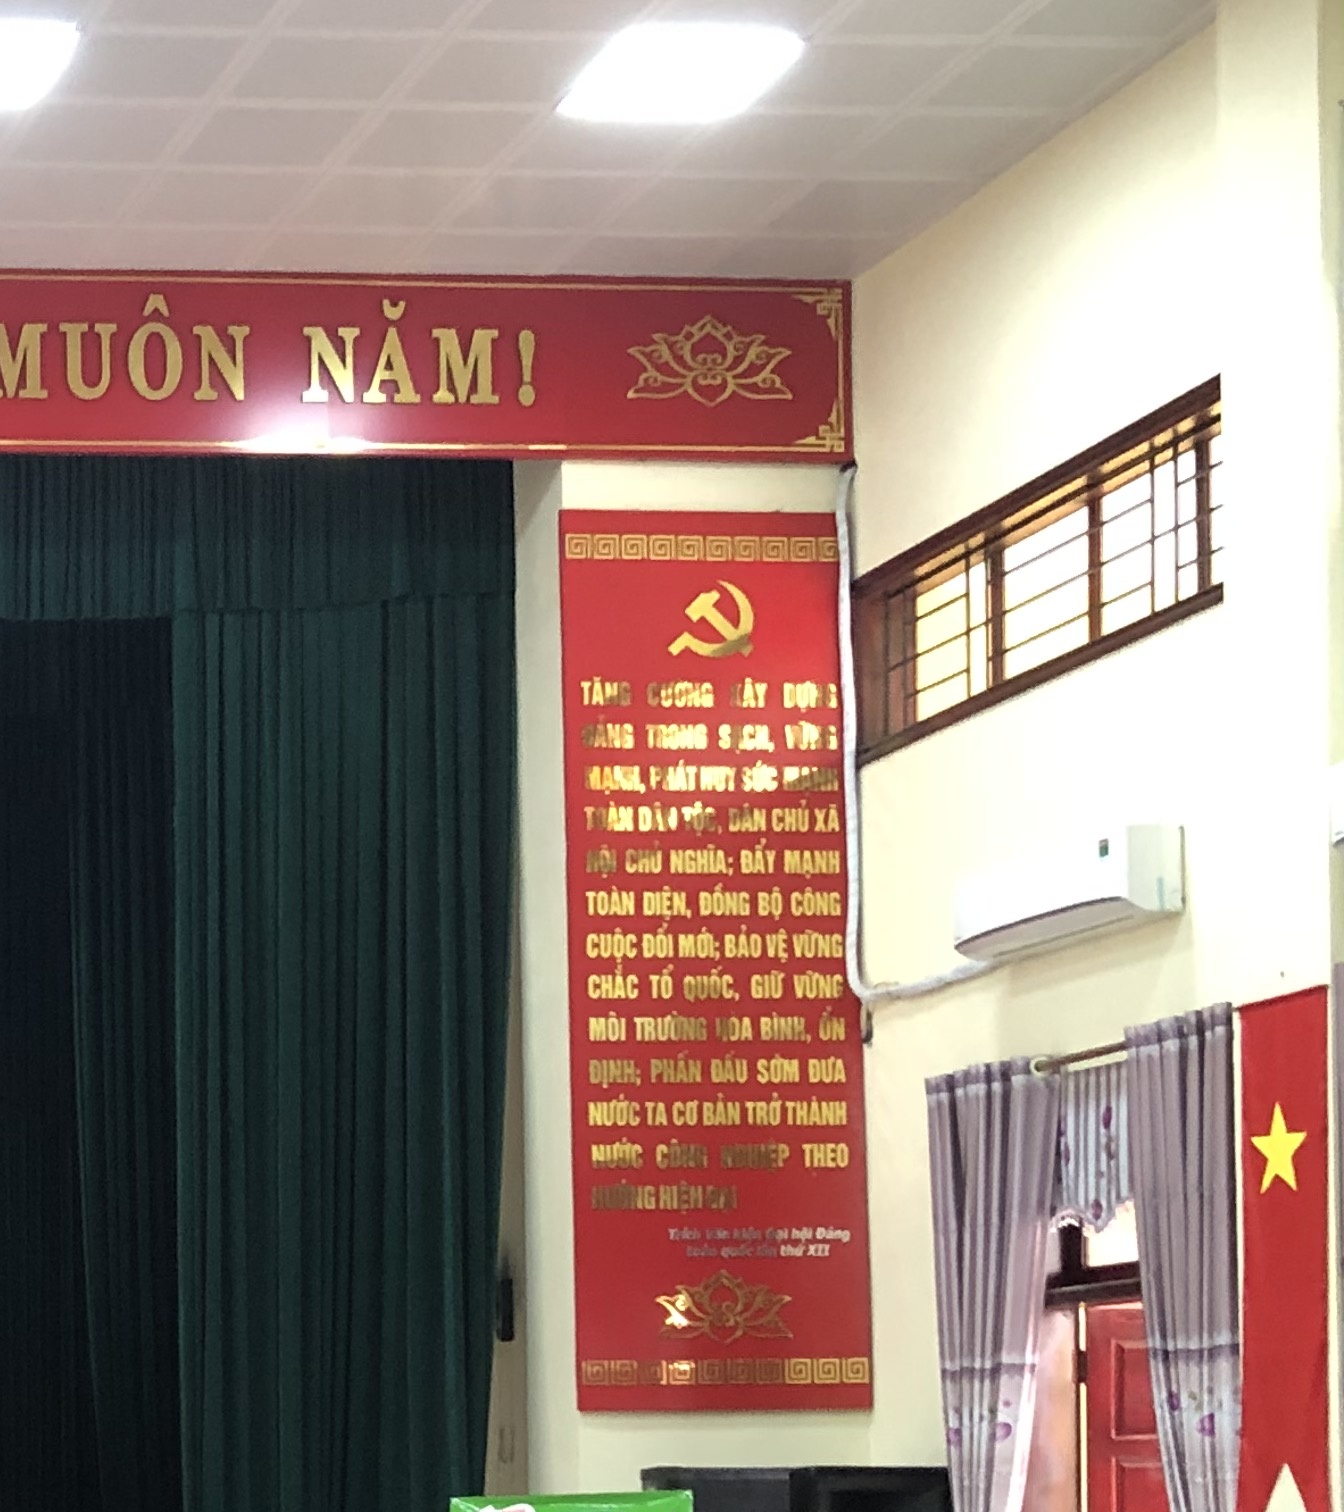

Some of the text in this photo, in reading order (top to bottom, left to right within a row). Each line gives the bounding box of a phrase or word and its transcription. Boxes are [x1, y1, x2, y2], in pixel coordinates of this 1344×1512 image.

[302, 298, 535, 406] NĂM!
[580, 676, 631, 706] TĂNG
[772, 799, 810, 832] CHỦ
[814, 803, 840, 832] XÃ
[625, 840, 663, 874] CHỦ
[784, 850, 840, 879] MẠNH
[585, 885, 635, 916] TOÀN
[642, 885, 691, 920] DIỆN,
[757, 886, 783, 921] BỘ
[791, 886, 842, 916] CÔNG
[586, 927, 638, 963] CUỘC
[724, 924, 762, 958] BẢO
[766, 927, 788, 963] VỆ
[793, 928, 843, 958] VỮNG
[588, 963, 843, 1003] CHẮC TỔ QUỐC, GIỮ VỮNG
[589, 1010, 626, 1041] MÔI
[633, 1010, 707, 1041] TRƯỜNG
[760, 1011, 812, 1044] BÌNH,
[756, 1053, 800, 1084] SỚM
[808, 1055, 846, 1084] ĐƯA
[588, 1091, 847, 1127] NƯỚC TA CƠ BẢN TRỞ THÀNH
[592, 1136, 643, 1169] NƯỚC
[801, 1143, 849, 1168] THEO
